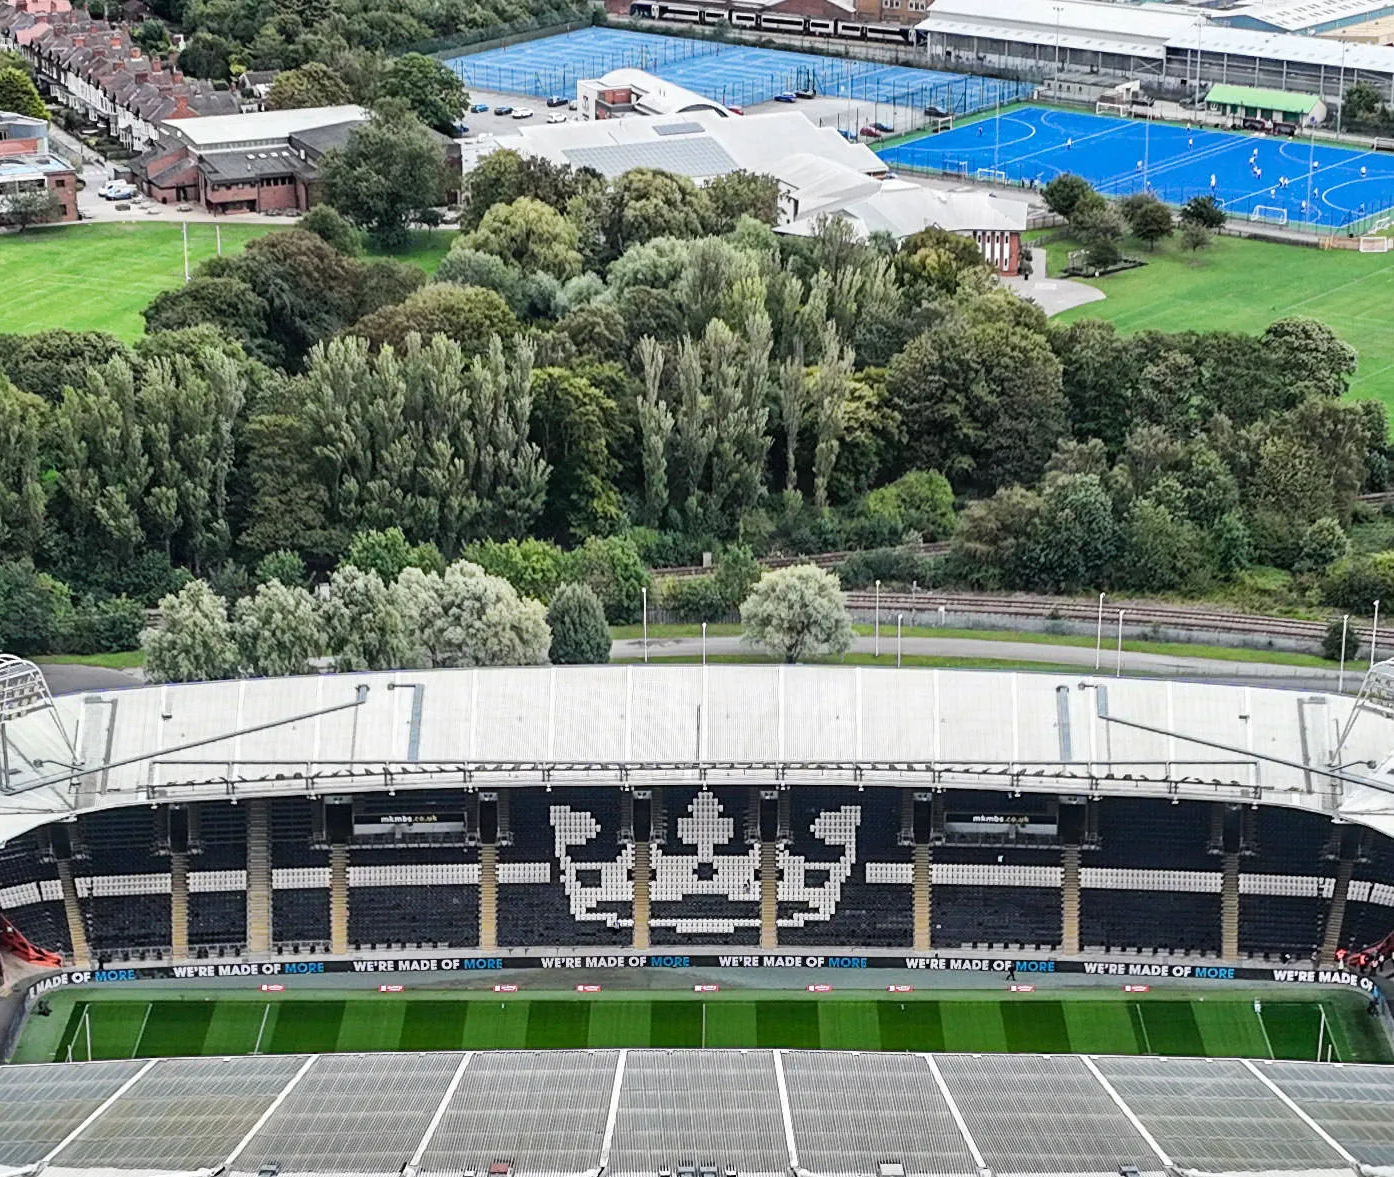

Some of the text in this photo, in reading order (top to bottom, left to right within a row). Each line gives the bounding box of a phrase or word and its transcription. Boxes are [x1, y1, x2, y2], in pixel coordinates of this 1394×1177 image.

[353, 958, 503, 972] WE'RE MADE OF MORE
[541, 956, 690, 969] WE'RE MADE OF MORE
[719, 956, 867, 968] WE'RE MADE OF MORE
[906, 958, 1055, 972] WE'RE MADE OF MORE
[173, 962, 325, 978] WE'RE MADE OF MORE
[1084, 962, 1235, 979] WE'RE MADE OF MORE
[37, 974, 68, 996] MADE
[71, 971, 91, 984] OF
[95, 969, 136, 982] MORE
[1273, 970, 1315, 982] WE'RE
[1319, 971, 1358, 986] MADE
[1360, 978, 1373, 992] OF
